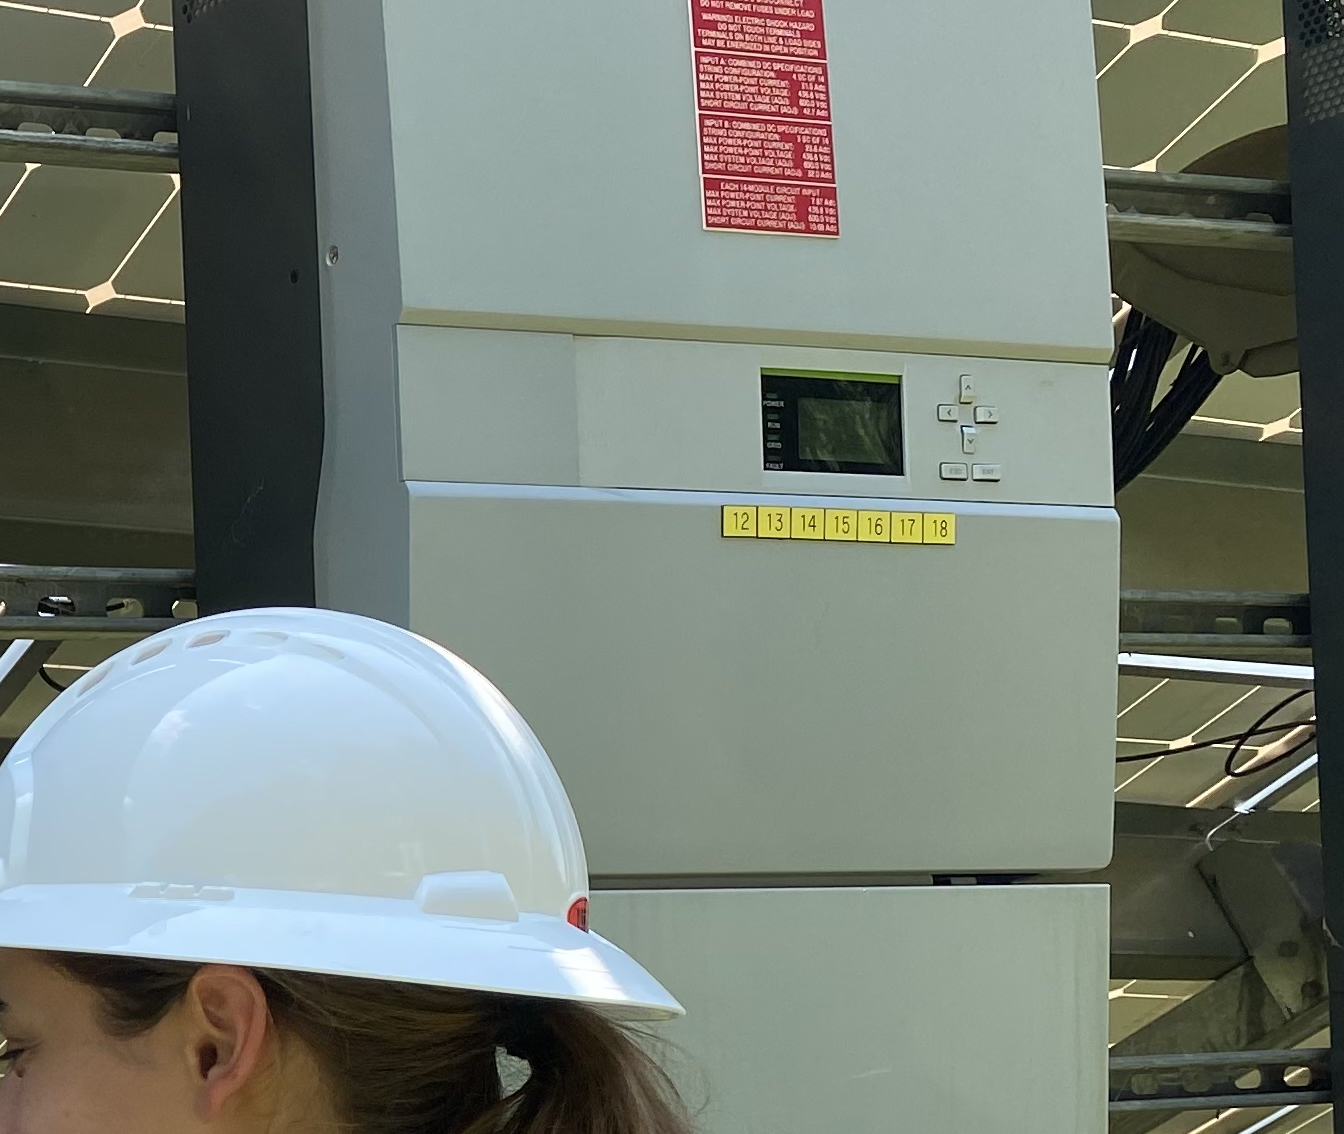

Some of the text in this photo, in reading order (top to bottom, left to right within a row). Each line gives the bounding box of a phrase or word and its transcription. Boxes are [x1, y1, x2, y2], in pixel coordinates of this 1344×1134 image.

[733, 512, 948, 538] 12 13 14 15 16 17 18
